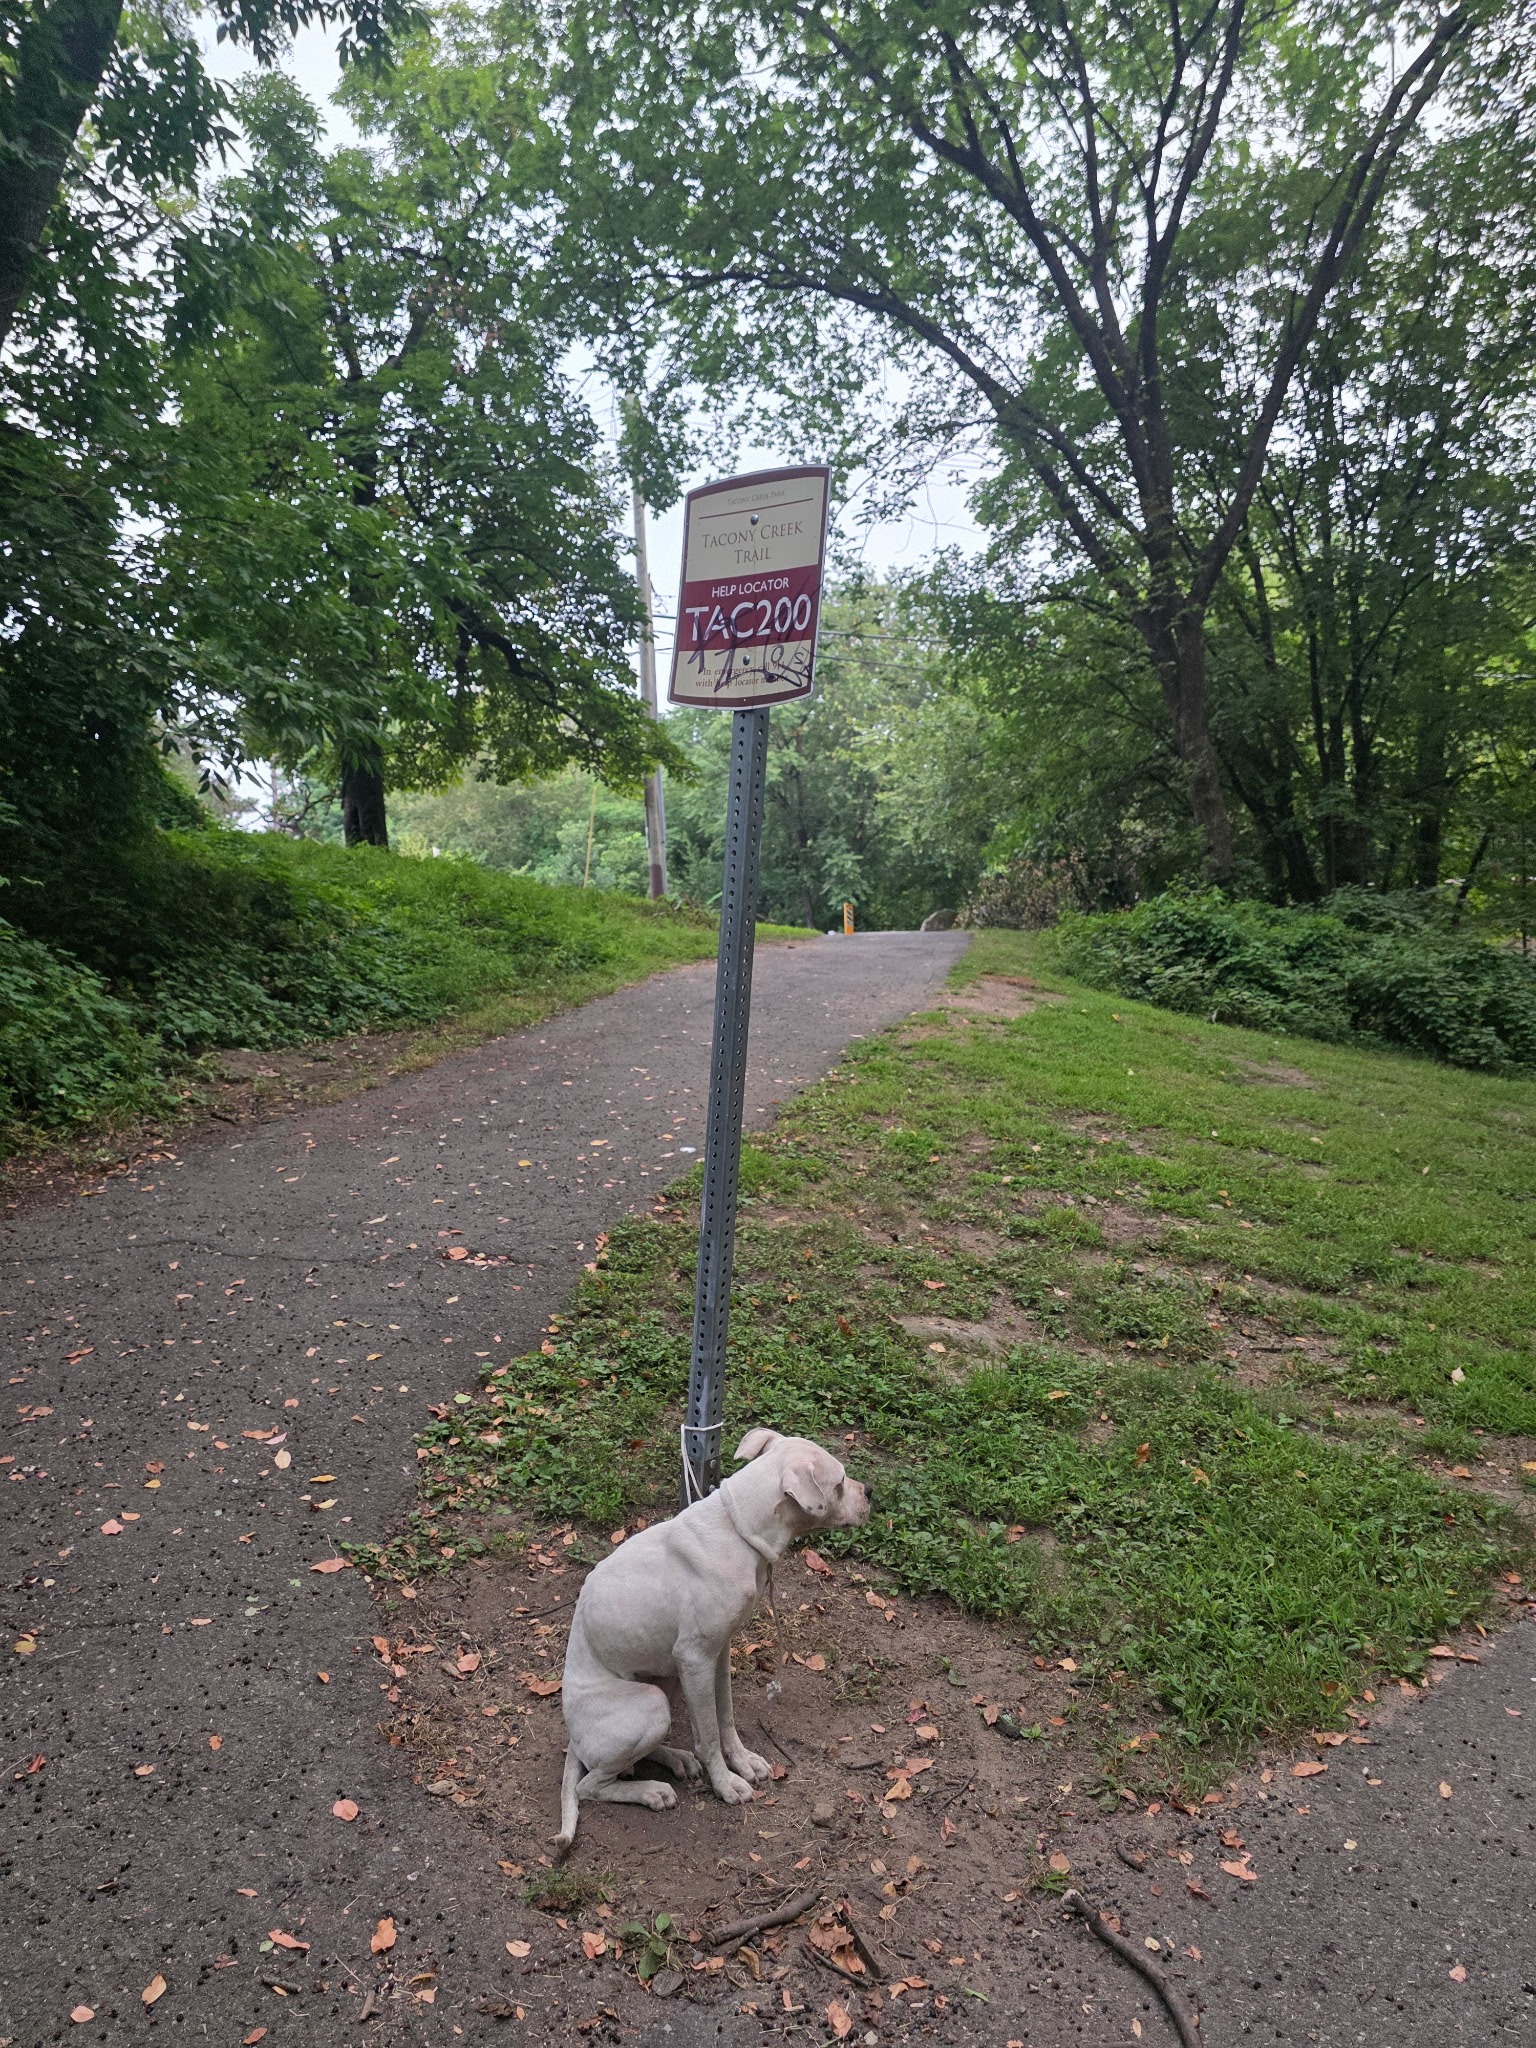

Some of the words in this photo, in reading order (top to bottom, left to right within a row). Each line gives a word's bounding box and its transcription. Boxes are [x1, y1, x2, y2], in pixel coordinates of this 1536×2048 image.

[702, 529, 757, 548] TACONY
[760, 520, 804, 540] CREEK
[734, 547, 771, 564] TRAIL
[712, 585, 737, 598] HELP
[738, 577, 789, 595] LOCATOR
[685, 593, 812, 642] TAC200
[703, 667, 711, 676] In
[695, 679, 713, 688] with
[734, 676, 760, 687] locator
